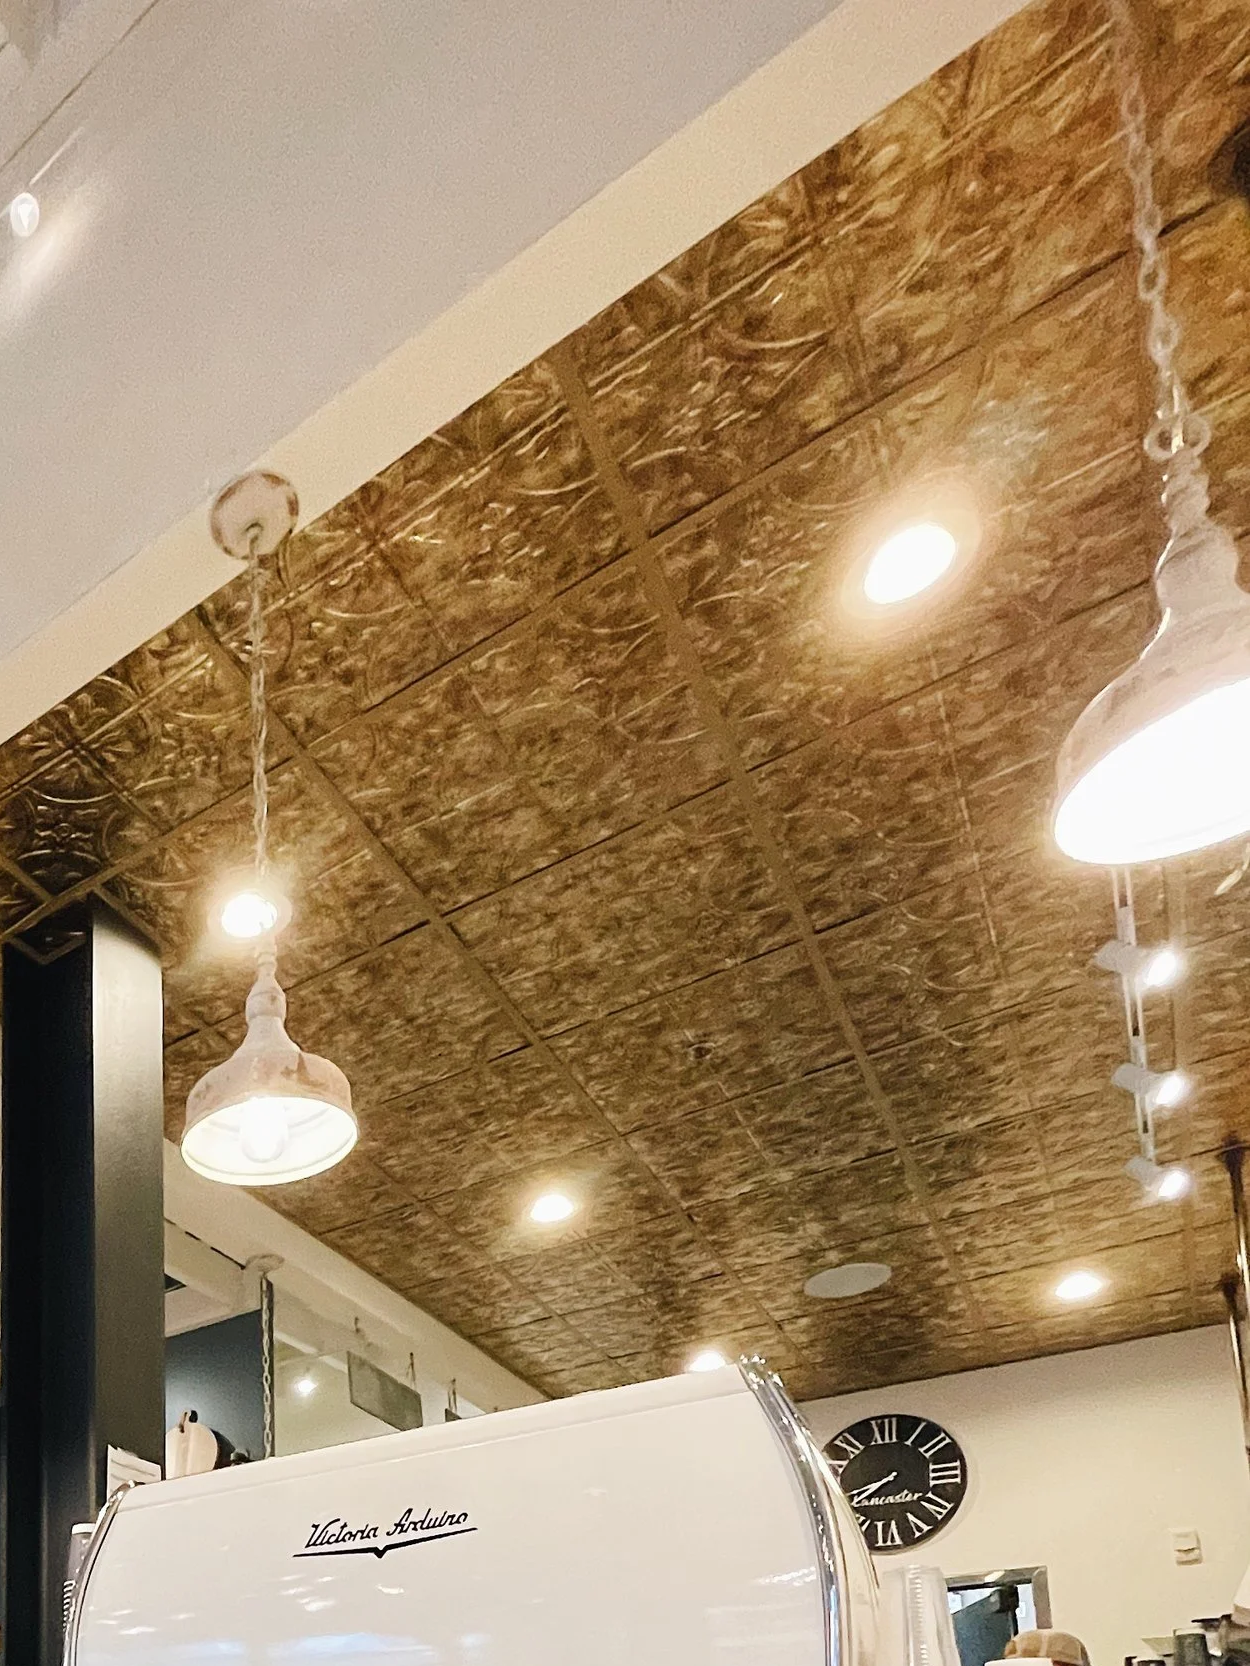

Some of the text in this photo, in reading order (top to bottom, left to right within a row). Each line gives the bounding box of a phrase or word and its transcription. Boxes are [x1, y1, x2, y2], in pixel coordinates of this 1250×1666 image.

[870, 1418, 898, 1446] XII
[918, 1431, 953, 1459] II
[929, 1459, 961, 1487] III
[920, 1490, 955, 1521] IV
[304, 1508, 468, 1548] Victoria Arduino
[875, 1520, 903, 1547] VI
[906, 1512, 934, 1538] V
